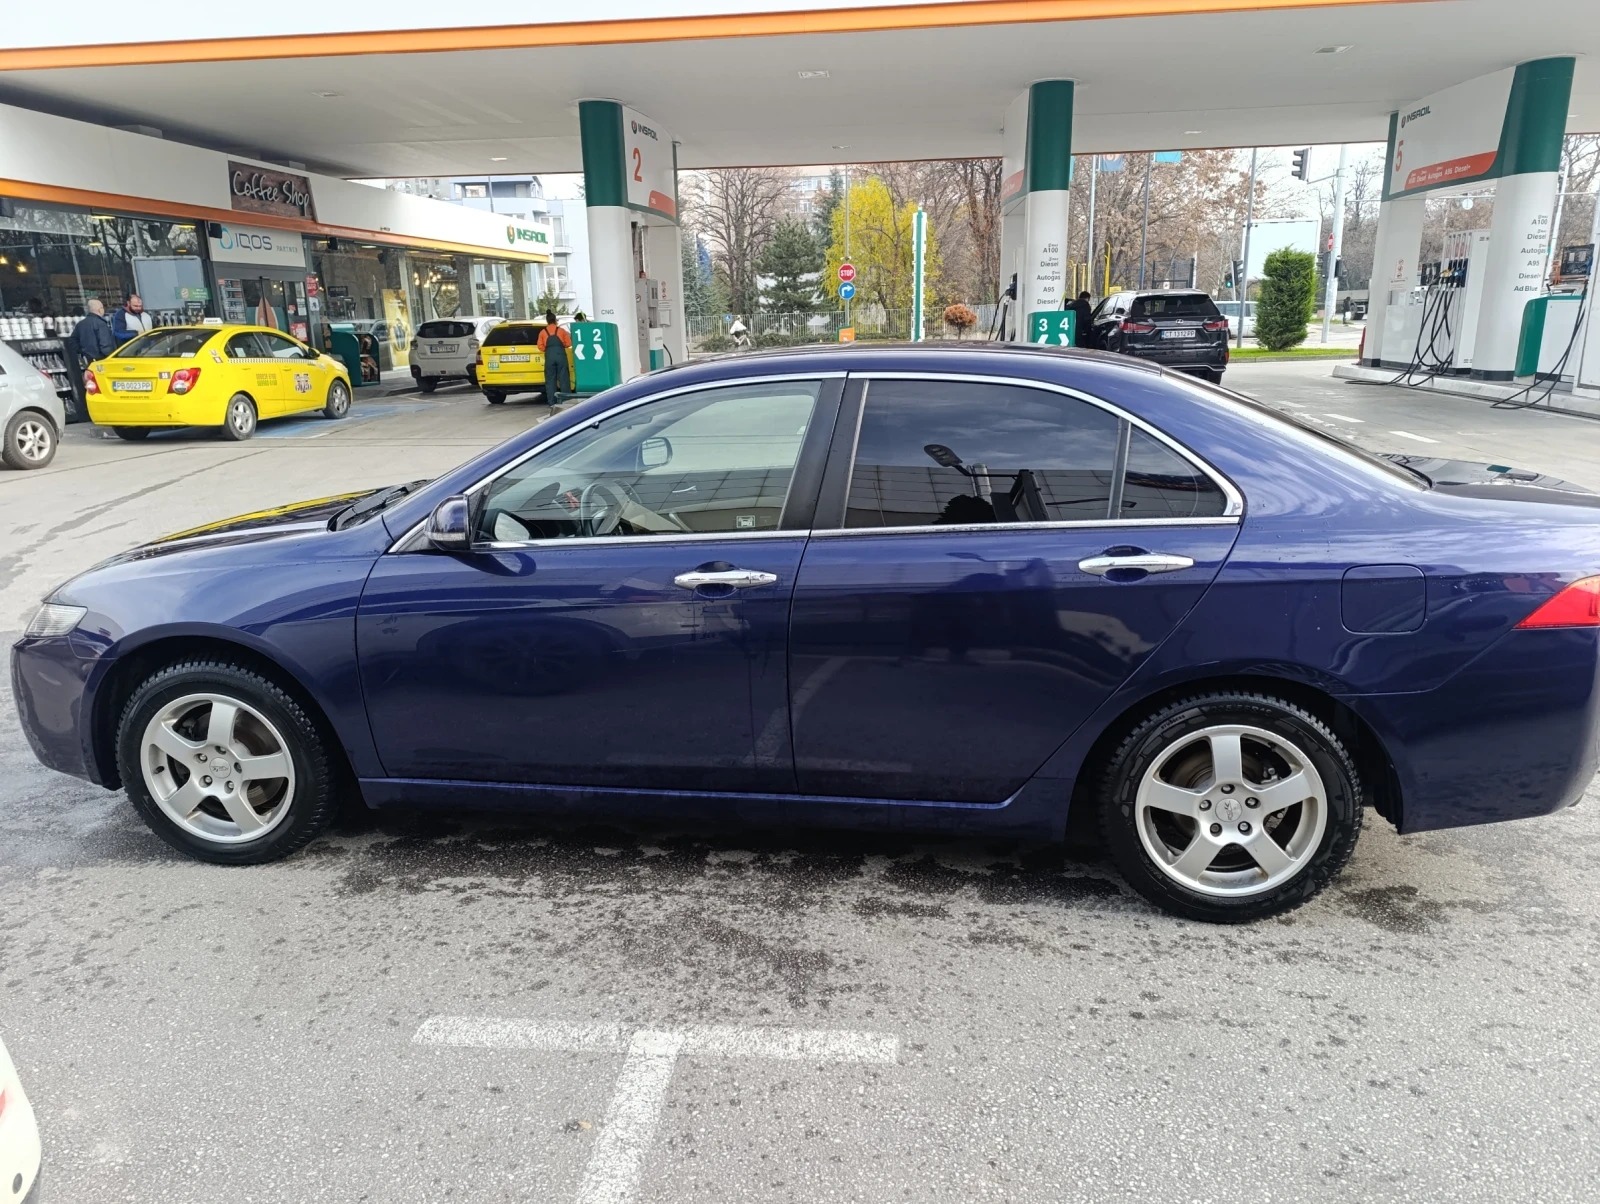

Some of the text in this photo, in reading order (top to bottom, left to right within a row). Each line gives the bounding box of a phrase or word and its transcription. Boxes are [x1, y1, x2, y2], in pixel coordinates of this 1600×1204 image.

[1395, 140, 1404, 172] 5
[633, 147, 643, 182] 2
[1428, 171, 1443, 181] Autogas
[233, 171, 310, 217] Coffee Shop
[235, 232, 298, 253] IQOS PARTNER
[1520, 247, 1546, 255] Autogas
[840, 269, 854, 277] STOP
[1039, 317, 1069, 331] 3 4
[574, 328, 602, 342] 1 2
